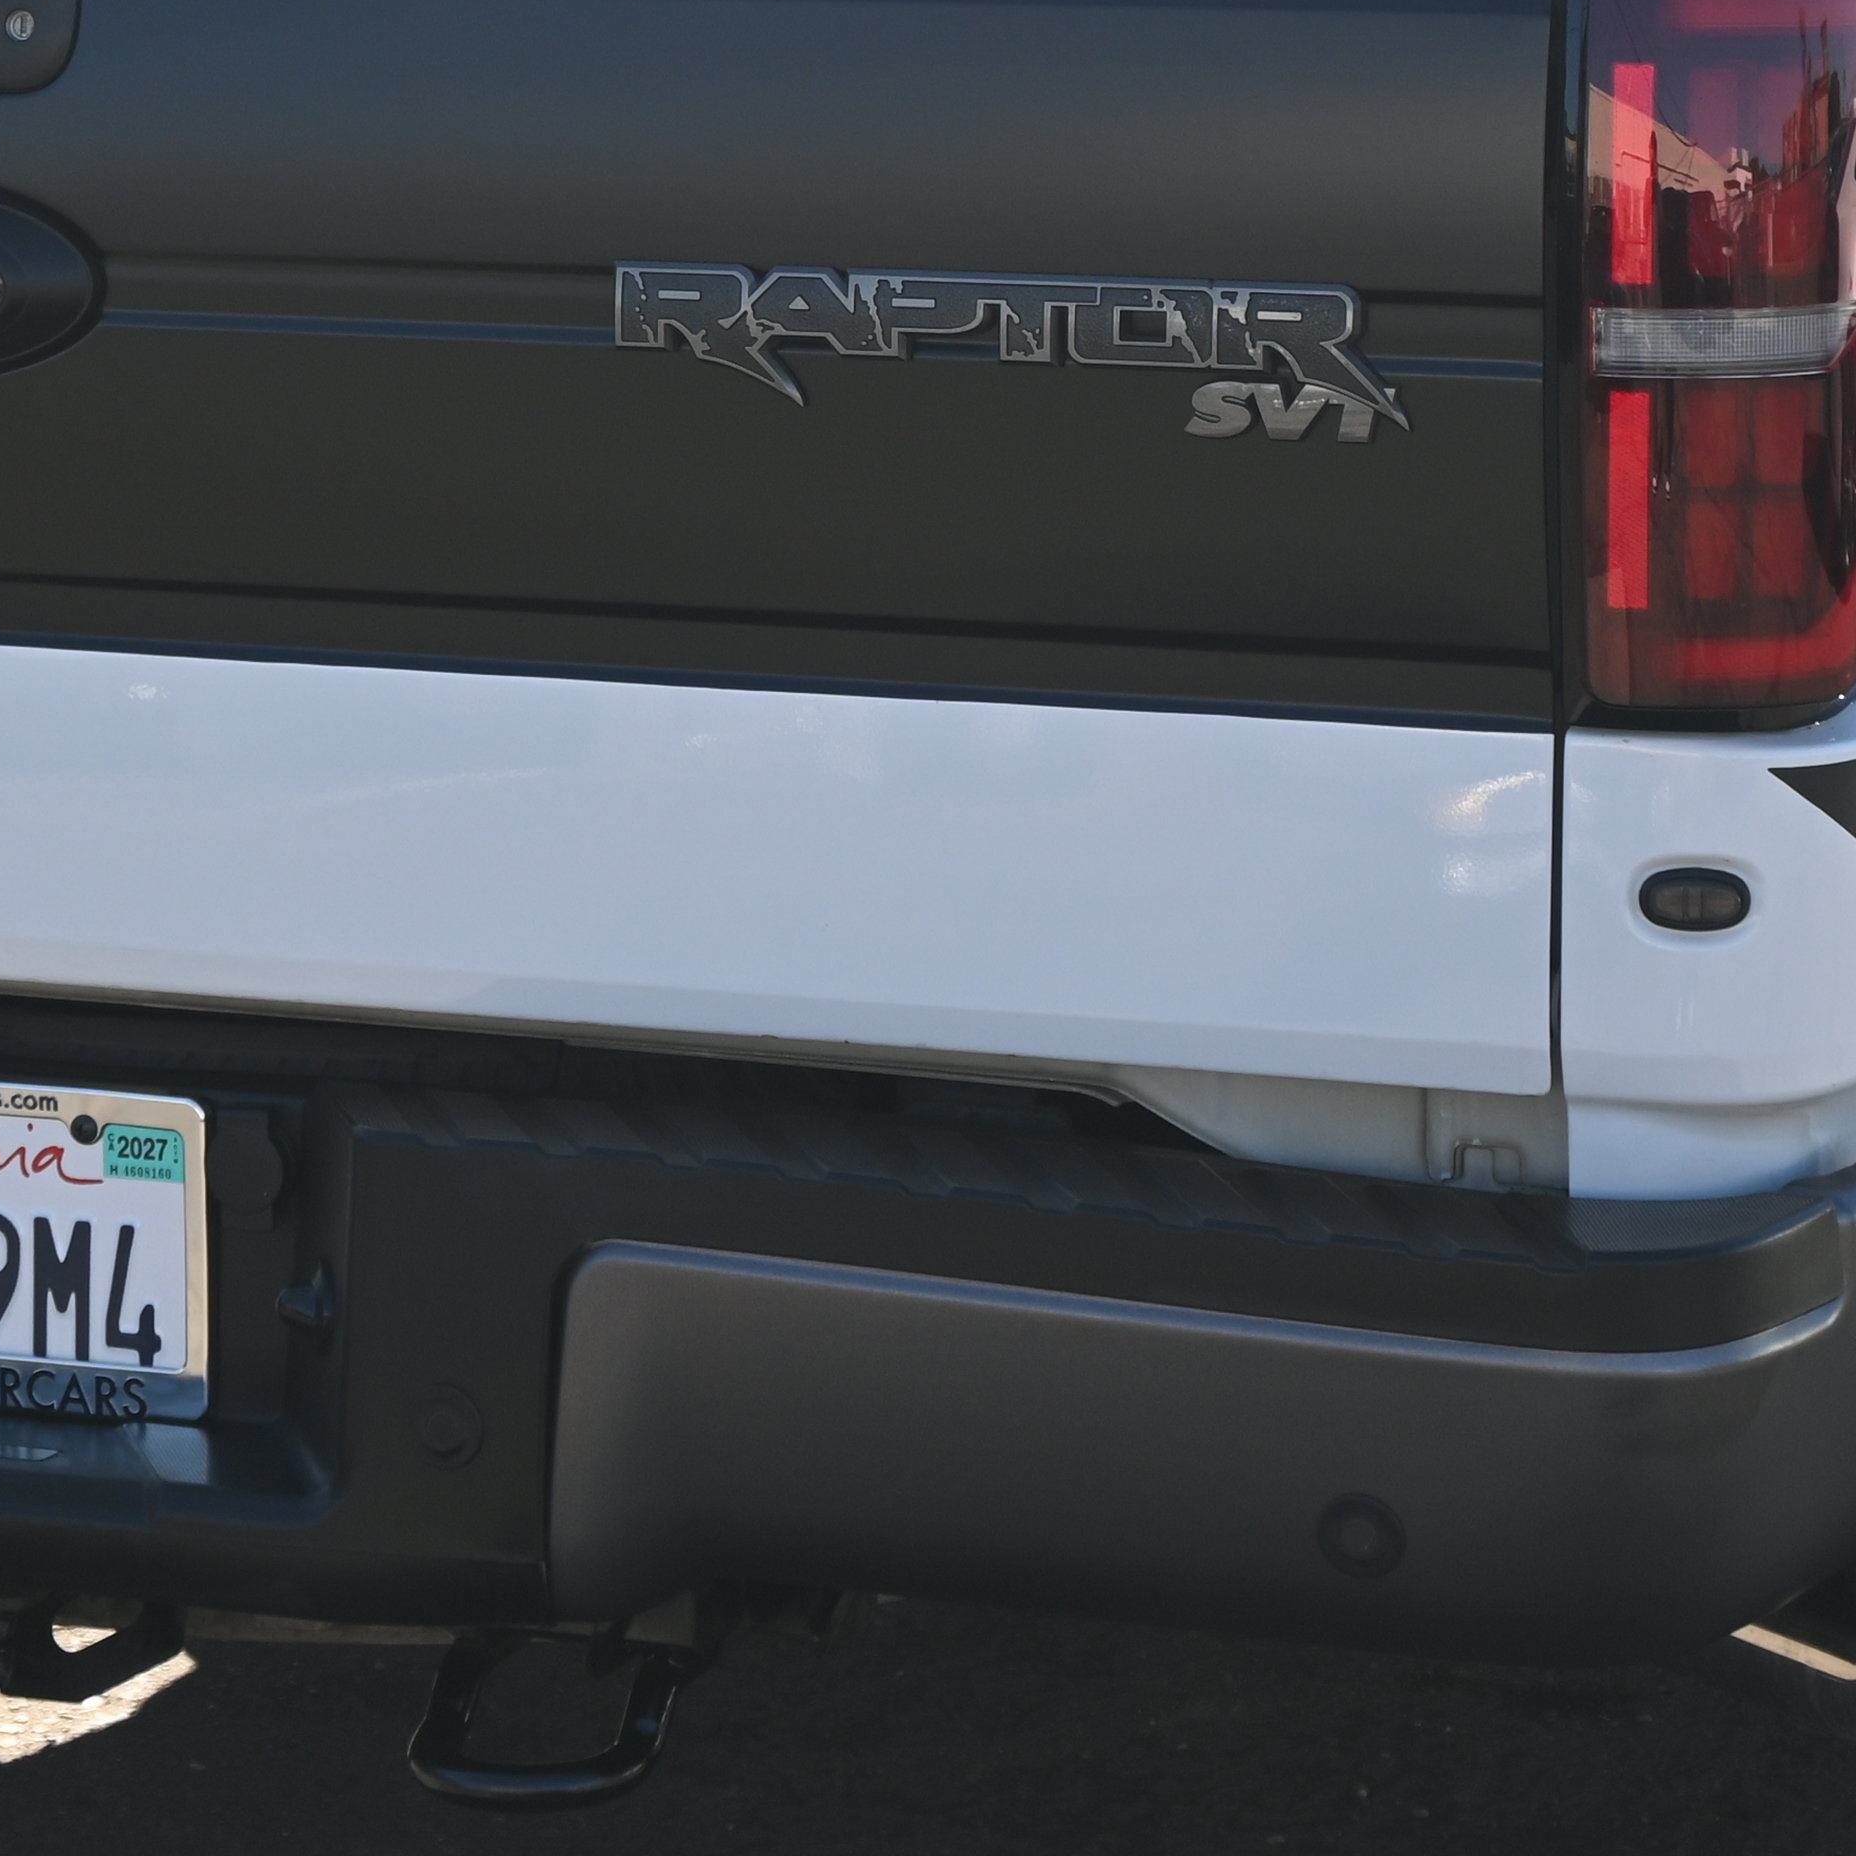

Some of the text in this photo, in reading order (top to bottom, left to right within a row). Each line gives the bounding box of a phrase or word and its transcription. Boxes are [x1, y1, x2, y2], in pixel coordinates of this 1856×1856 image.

[614, 260, 1409, 431] RAPTOR
[1185, 381, 1400, 443] SVT
[117, 1136, 168, 1161] 2027
